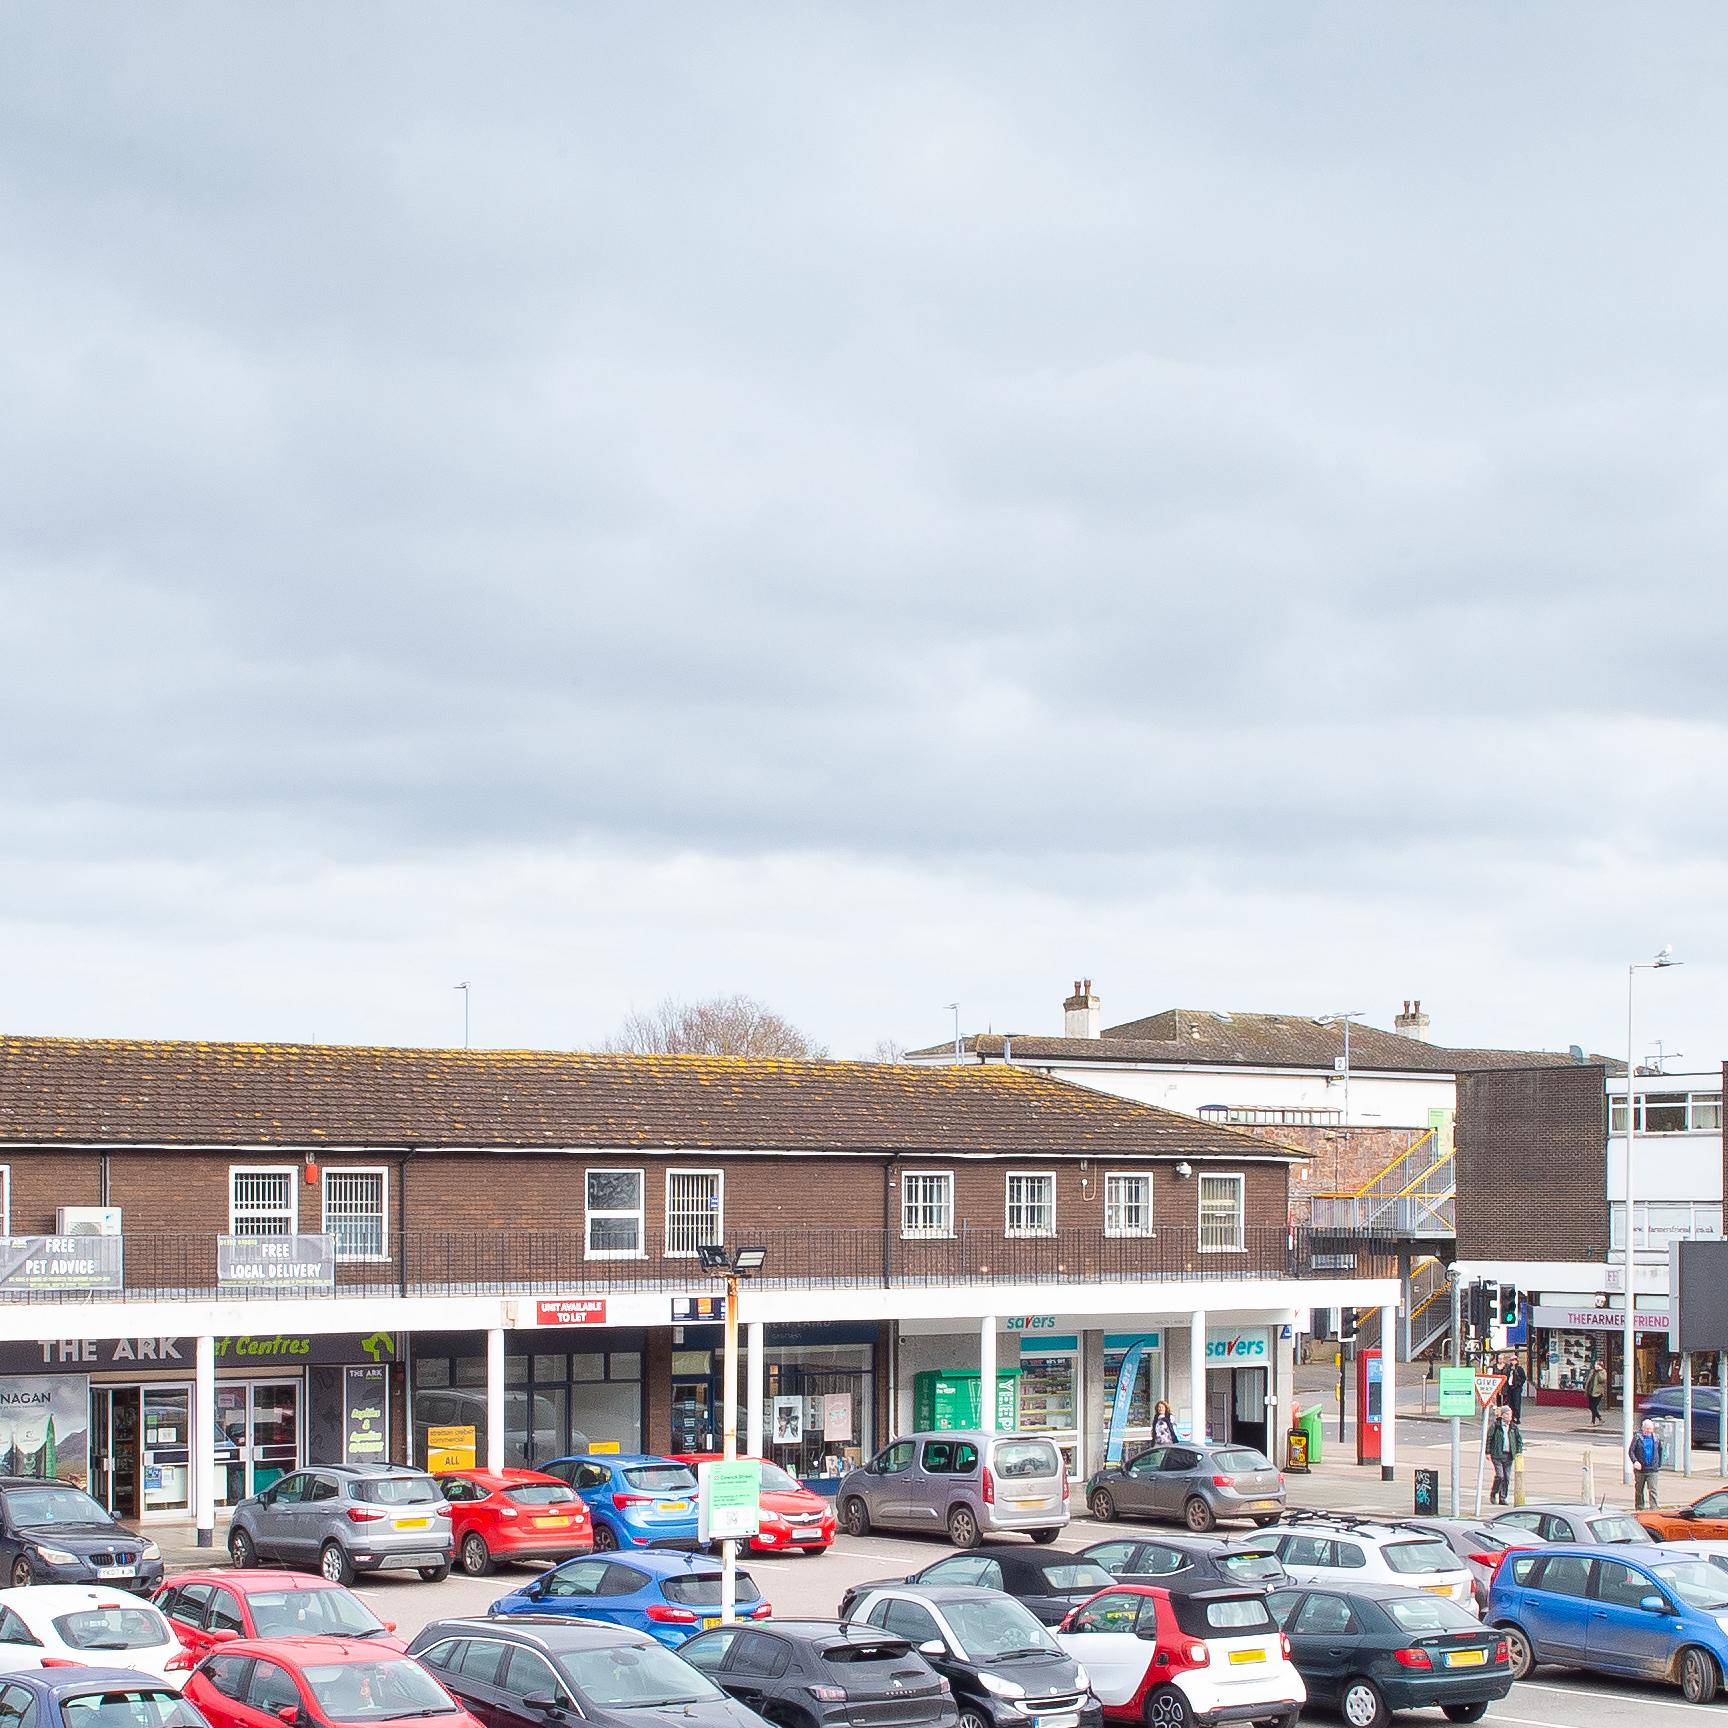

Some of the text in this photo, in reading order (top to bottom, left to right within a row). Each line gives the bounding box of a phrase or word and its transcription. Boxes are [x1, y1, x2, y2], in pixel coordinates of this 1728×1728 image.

[45, 1238, 75, 1253] FREE
[261, 1243, 290, 1258] FREE
[25, 1259, 95, 1275] PET ADVICE
[230, 1262, 322, 1279] LOCAL DELIVERY
[541, 1301, 602, 1312] UNIT AVAILABLE
[557, 1312, 587, 1322] TO LET
[1007, 1315, 1056, 1329] savers
[37, 1339, 98, 1363] THE
[111, 1337, 183, 1361] ARK
[235, 1335, 312, 1356] Centres
[1206, 1335, 1265, 1357] savers
[1476, 1378, 1497, 1386] GIVE
[444, 1457, 460, 1465] ALL
